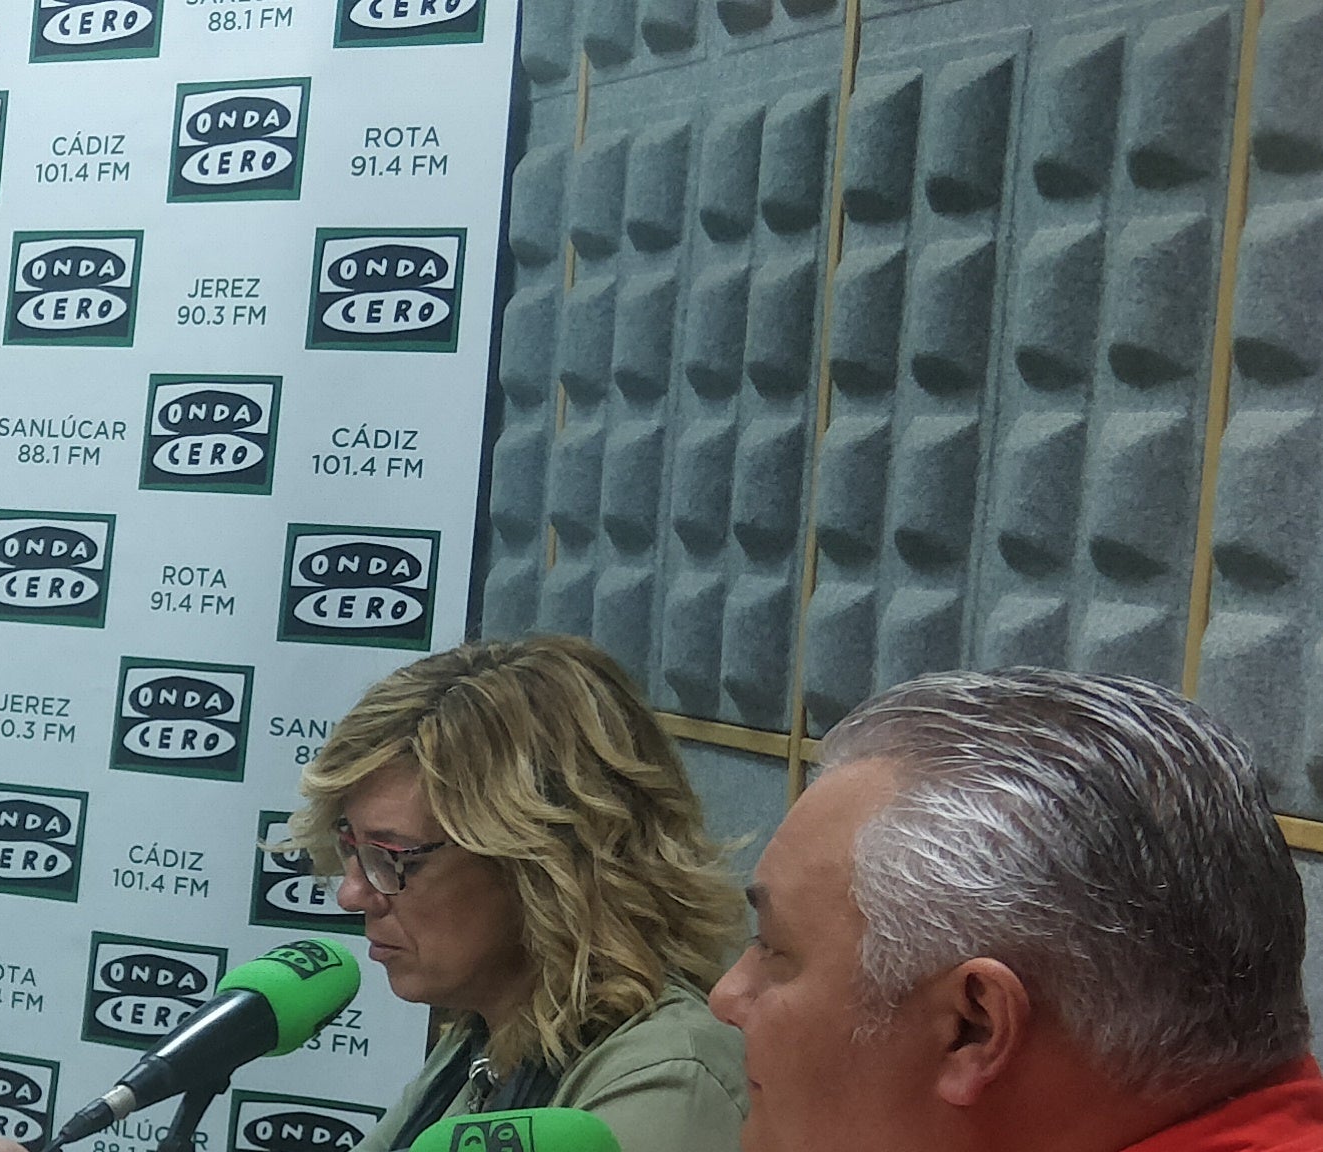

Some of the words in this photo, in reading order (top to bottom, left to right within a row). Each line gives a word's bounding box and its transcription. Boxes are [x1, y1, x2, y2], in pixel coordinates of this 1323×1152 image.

[58, 9, 138, 35] CERO
[208, 9, 252, 31] 88.1
[260, 7, 293, 29] FM
[196, 109, 281, 134] ONDA
[52, 131, 126, 156] CÁDIZ
[364, 126, 440, 149] ROTA
[35, 163, 89, 183] 101.4
[97, 161, 130, 182] FM
[197, 150, 278, 176] CERO
[351, 155, 402, 177] 91.4
[411, 154, 449, 176] FM
[31, 258, 116, 281] ONDA
[339, 258, 439, 282] ONDA
[187, 278, 261, 298] JEREZ
[32, 298, 113, 320] CERO
[177, 304, 225, 326] 90.3
[233, 305, 267, 326] FM
[341, 299, 435, 324] CERO
[166, 402, 252, 425] ONDA
[331, 423, 420, 451] CÁDIZ
[17, 444, 60, 464] 88.1
[67, 446, 101, 467] FM
[167, 443, 249, 466] CERO
[311, 454, 378, 477] 101.4
[386, 457, 424, 479] FM
[3, 538, 89, 559] ONDA
[161, 565, 228, 590] ROTA
[310, 554, 412, 577] ONDA
[4, 576, 86, 600] CERO
[150, 591, 193, 614] 91.4
[200, 594, 236, 616] FM
[312, 595, 409, 621] CERO
[137, 686, 224, 712] ONDA
[43, 722, 76, 744] FM
[138, 726, 220, 751] CERO
[128, 842, 205, 872] CÁDIZ
[112, 868, 165, 893] 101.4
[174, 875, 210, 898] FM
[109, 962, 198, 990] ONDA
[11, 991, 44, 1013] FM
[331, 1033, 369, 1057] FM
[255, 1121, 354, 1149] ONDA
